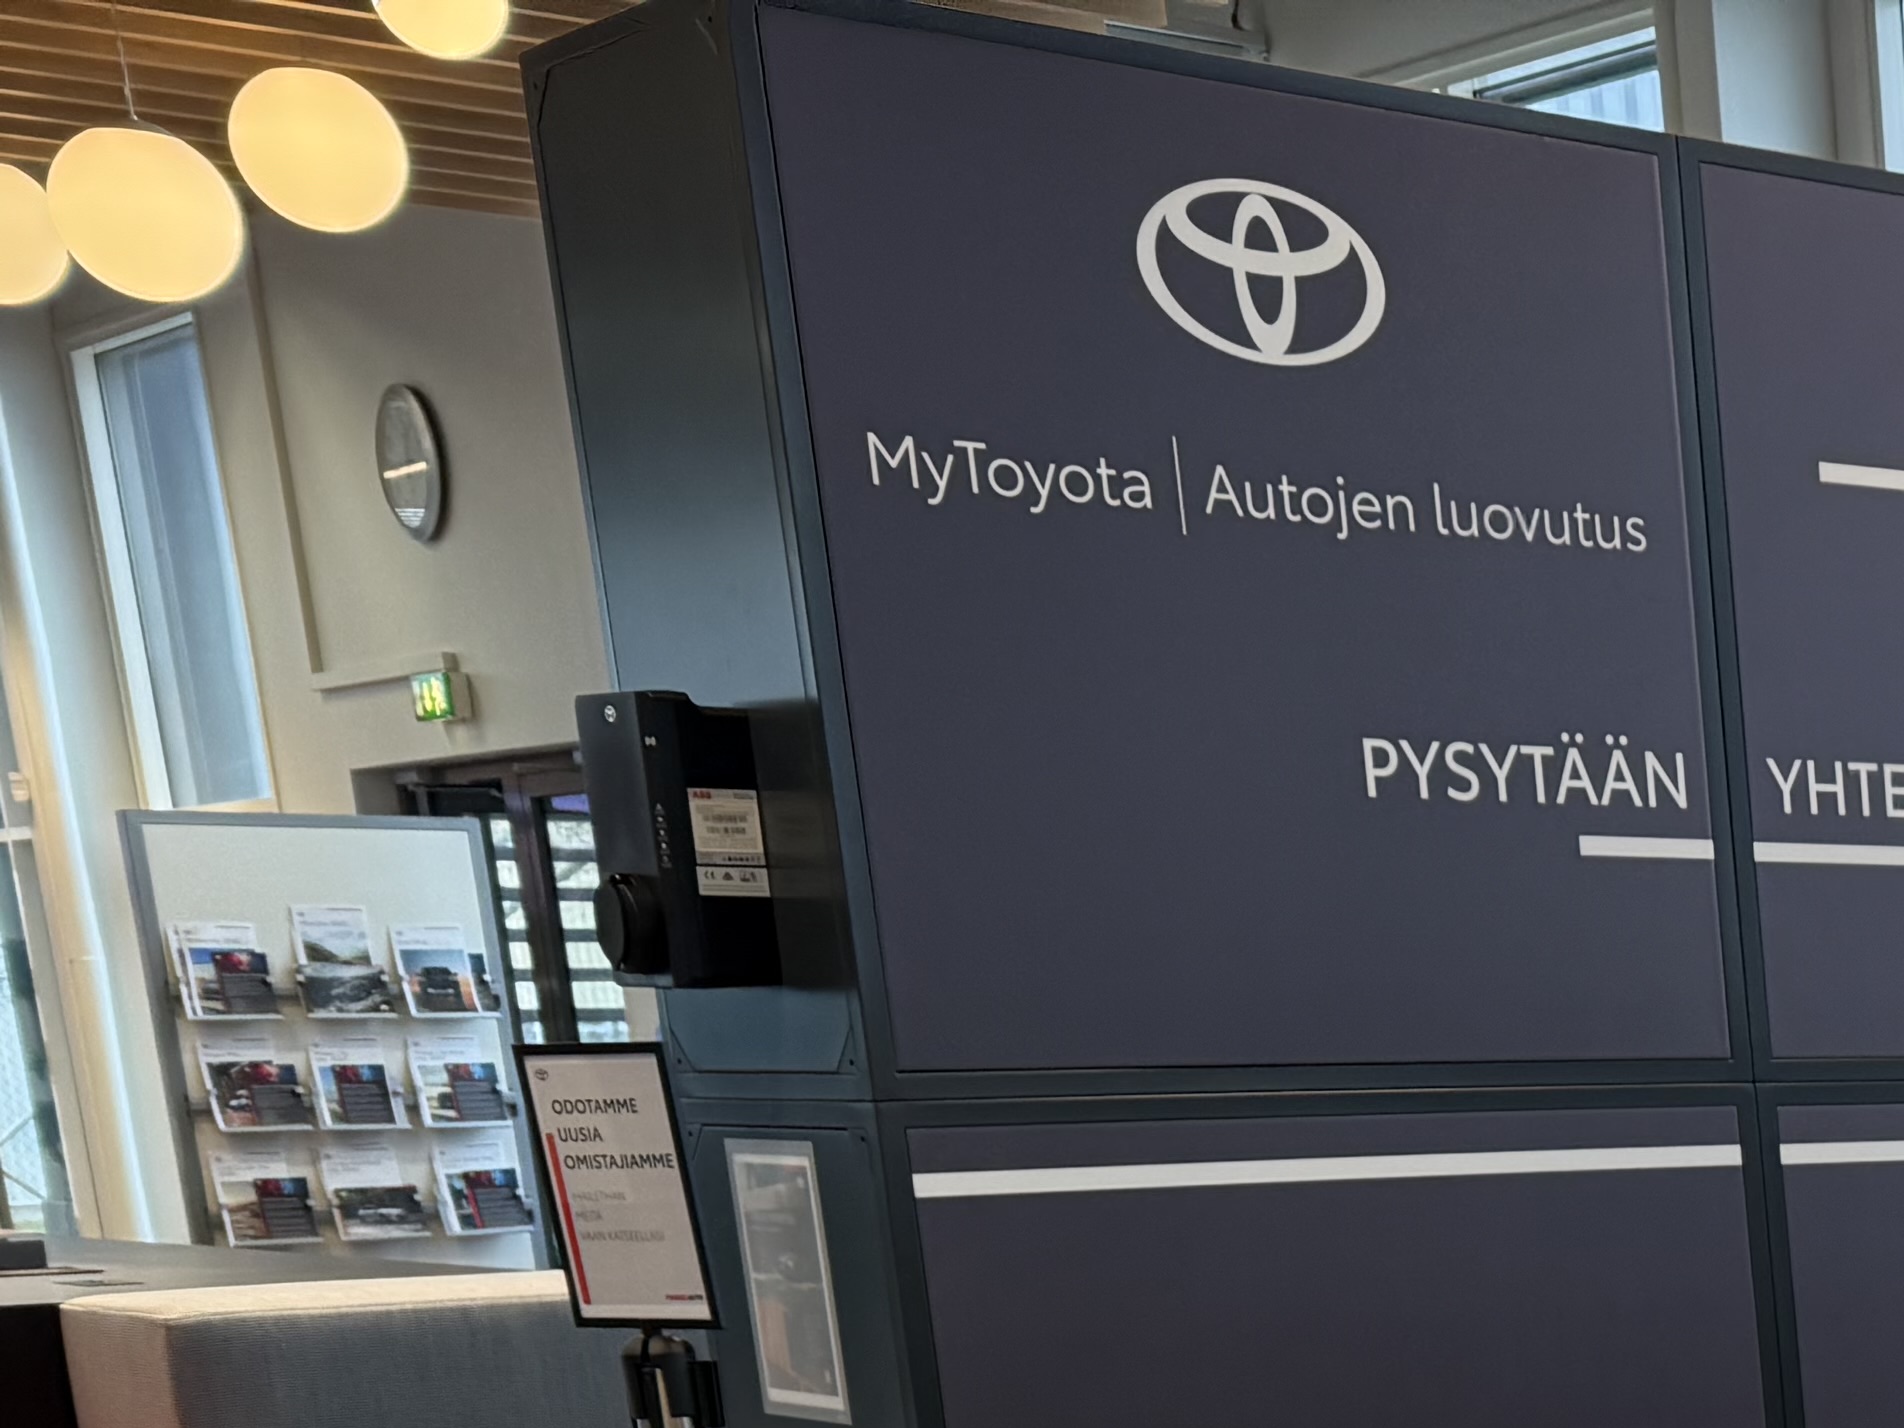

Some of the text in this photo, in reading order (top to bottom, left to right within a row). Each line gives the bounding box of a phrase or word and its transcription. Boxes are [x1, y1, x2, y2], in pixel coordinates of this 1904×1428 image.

[866, 431, 1648, 553] MyToyota Autojen luovutus
[1362, 731, 1688, 810] PYSYTÄÄN
[552, 1098, 639, 1115] ODOTAMME
[557, 1127, 604, 1143] UUSIA
[564, 1153, 675, 1170] OMISTAJIAMME
